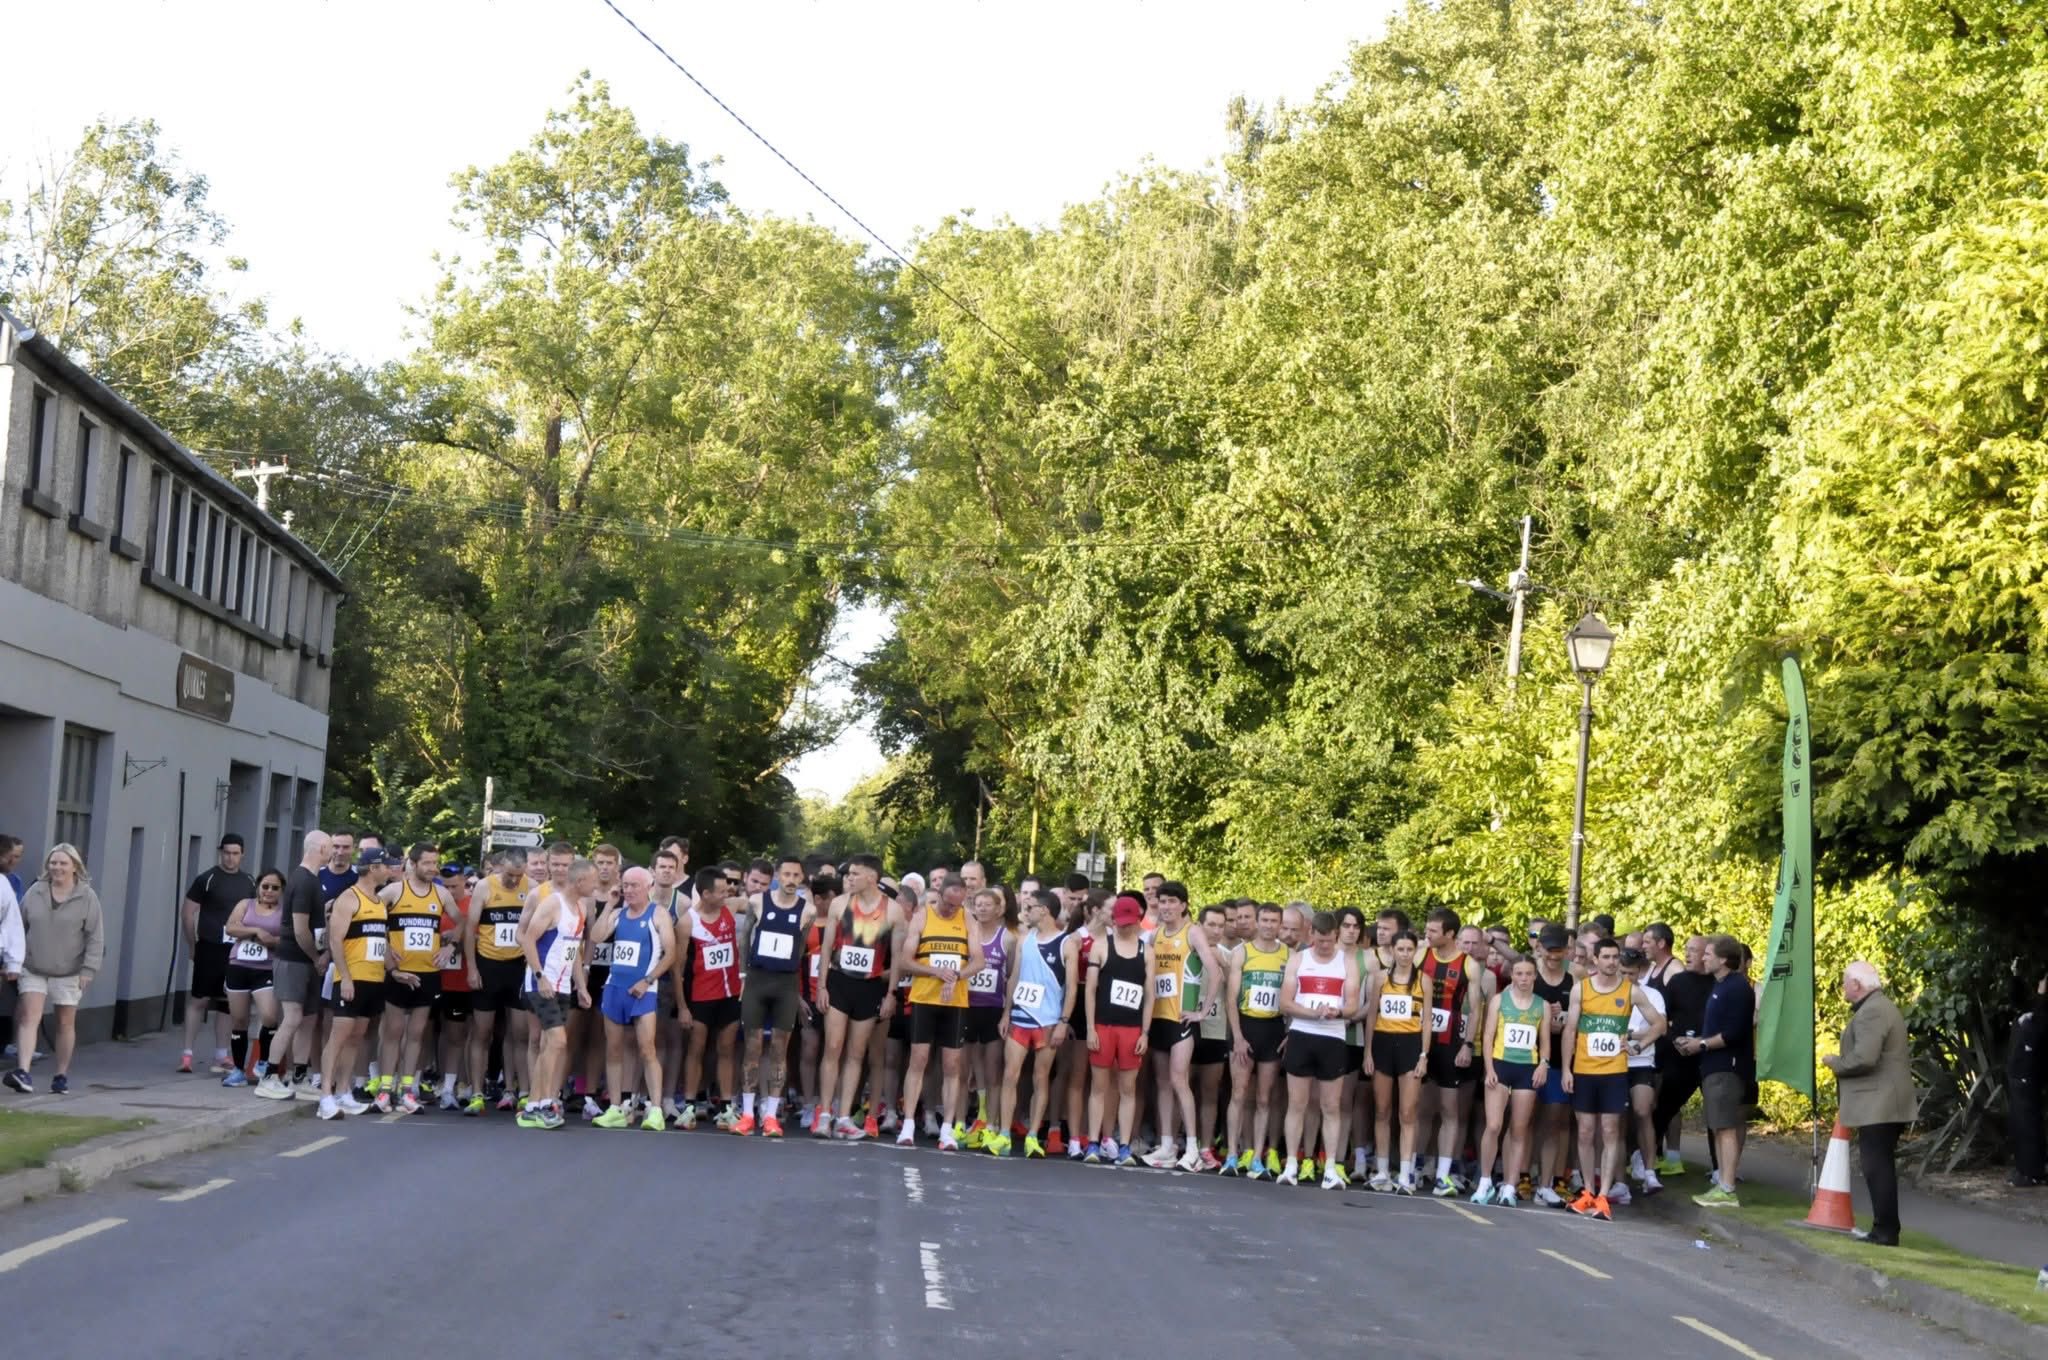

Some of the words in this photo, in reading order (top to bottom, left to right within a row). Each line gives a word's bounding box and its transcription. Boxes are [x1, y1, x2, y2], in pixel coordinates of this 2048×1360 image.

[409, 932, 431, 946] 532
[500, 928, 513, 942] 41
[242, 943, 263, 956] 469
[565, 947, 576, 960] 30
[615, 945, 634, 960] 369
[930, 942, 959, 952] LEEVALE
[709, 948, 730, 965] 397
[845, 951, 868, 968] 386
[970, 973, 992, 987] 355
[1156, 978, 1172, 993] 198
[1016, 986, 1038, 1002] 215
[1116, 986, 1138, 1003] 212
[1254, 991, 1276, 1007] 401
[1385, 1000, 1407, 1014] 348
[1508, 1029, 1531, 1044] 371
[1592, 1038, 1616, 1052] 466
